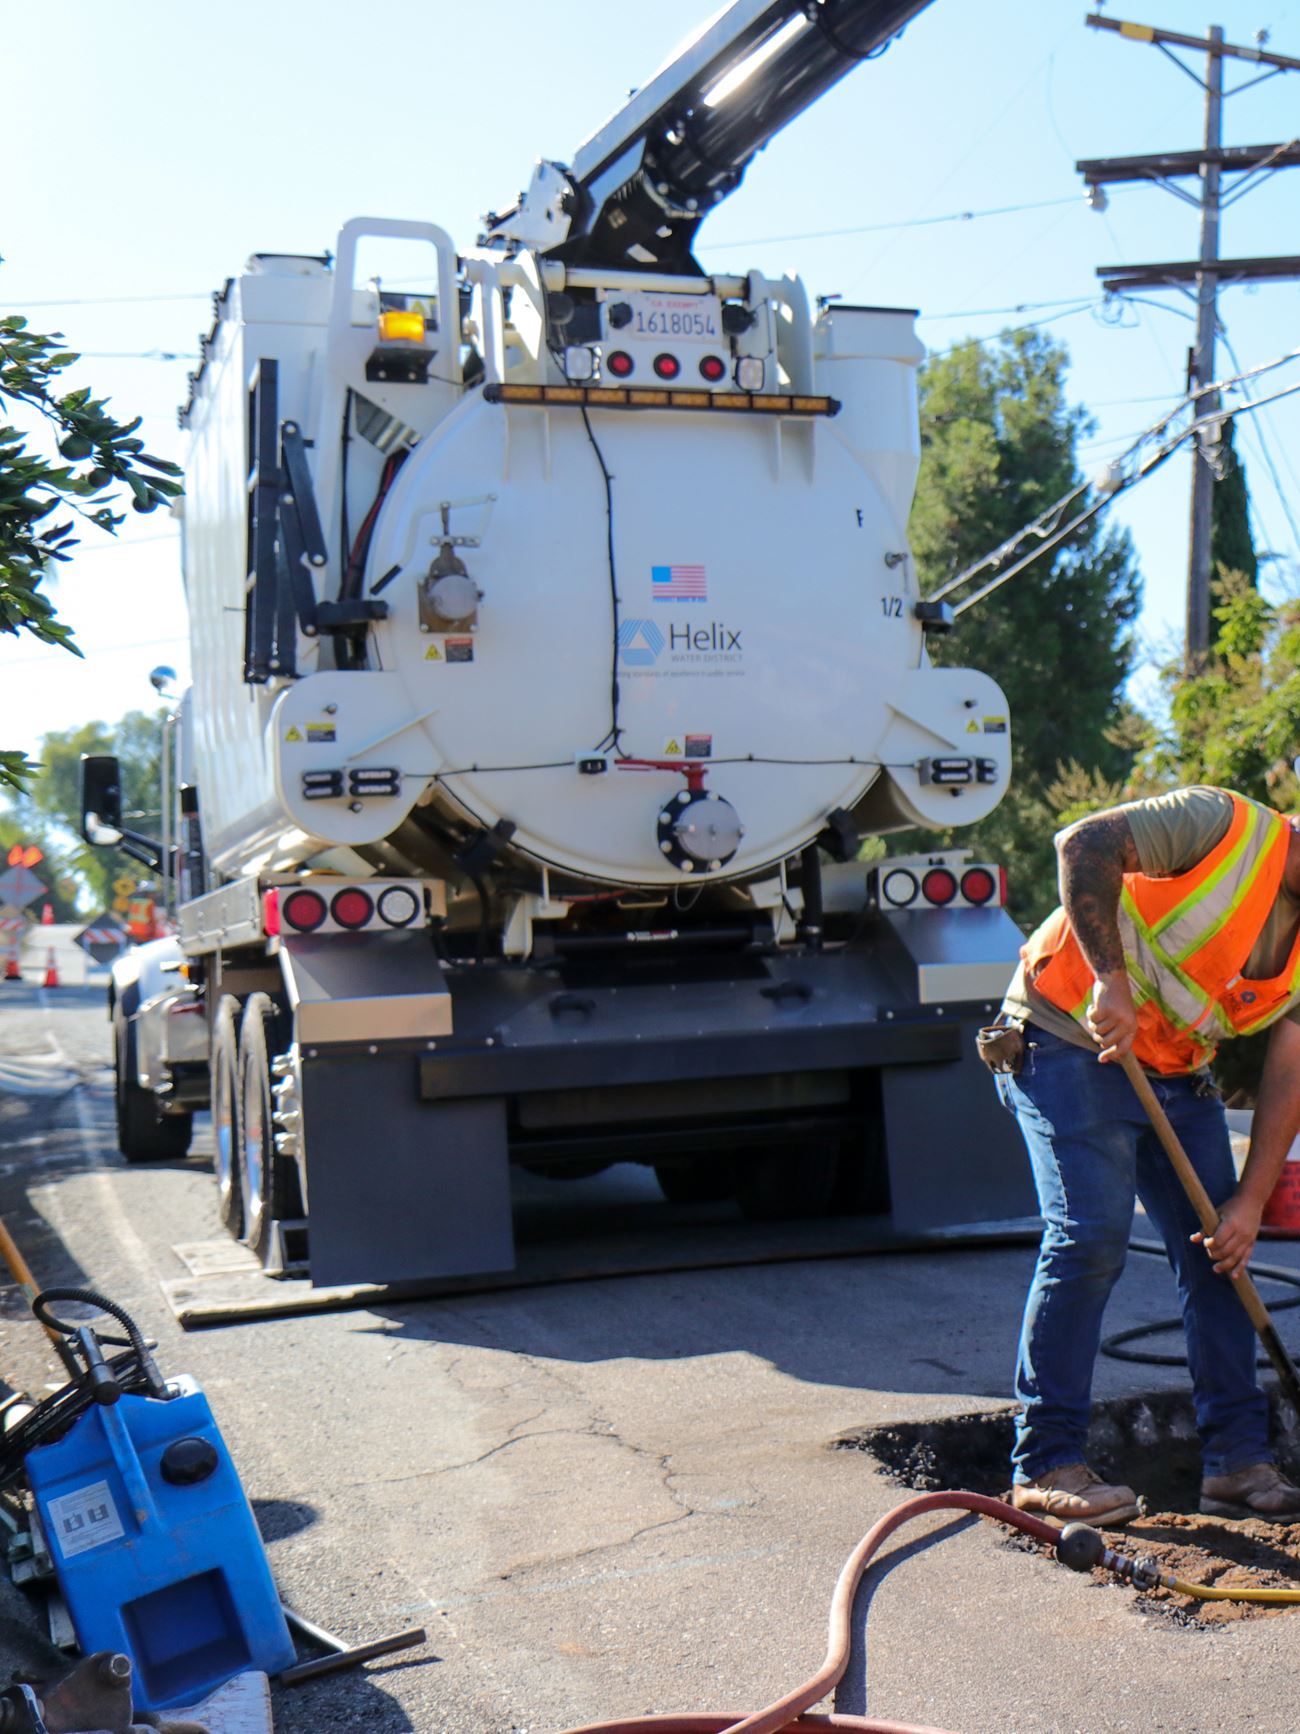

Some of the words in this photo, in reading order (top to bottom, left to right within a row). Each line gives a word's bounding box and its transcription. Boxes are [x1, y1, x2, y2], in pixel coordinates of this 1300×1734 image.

[636, 311, 716, 336] 1618054
[881, 596, 904, 618] 1/2
[670, 621, 743, 650] Helix
[671, 654, 701, 663] WATER
[703, 654, 743, 663] DISTRICT
